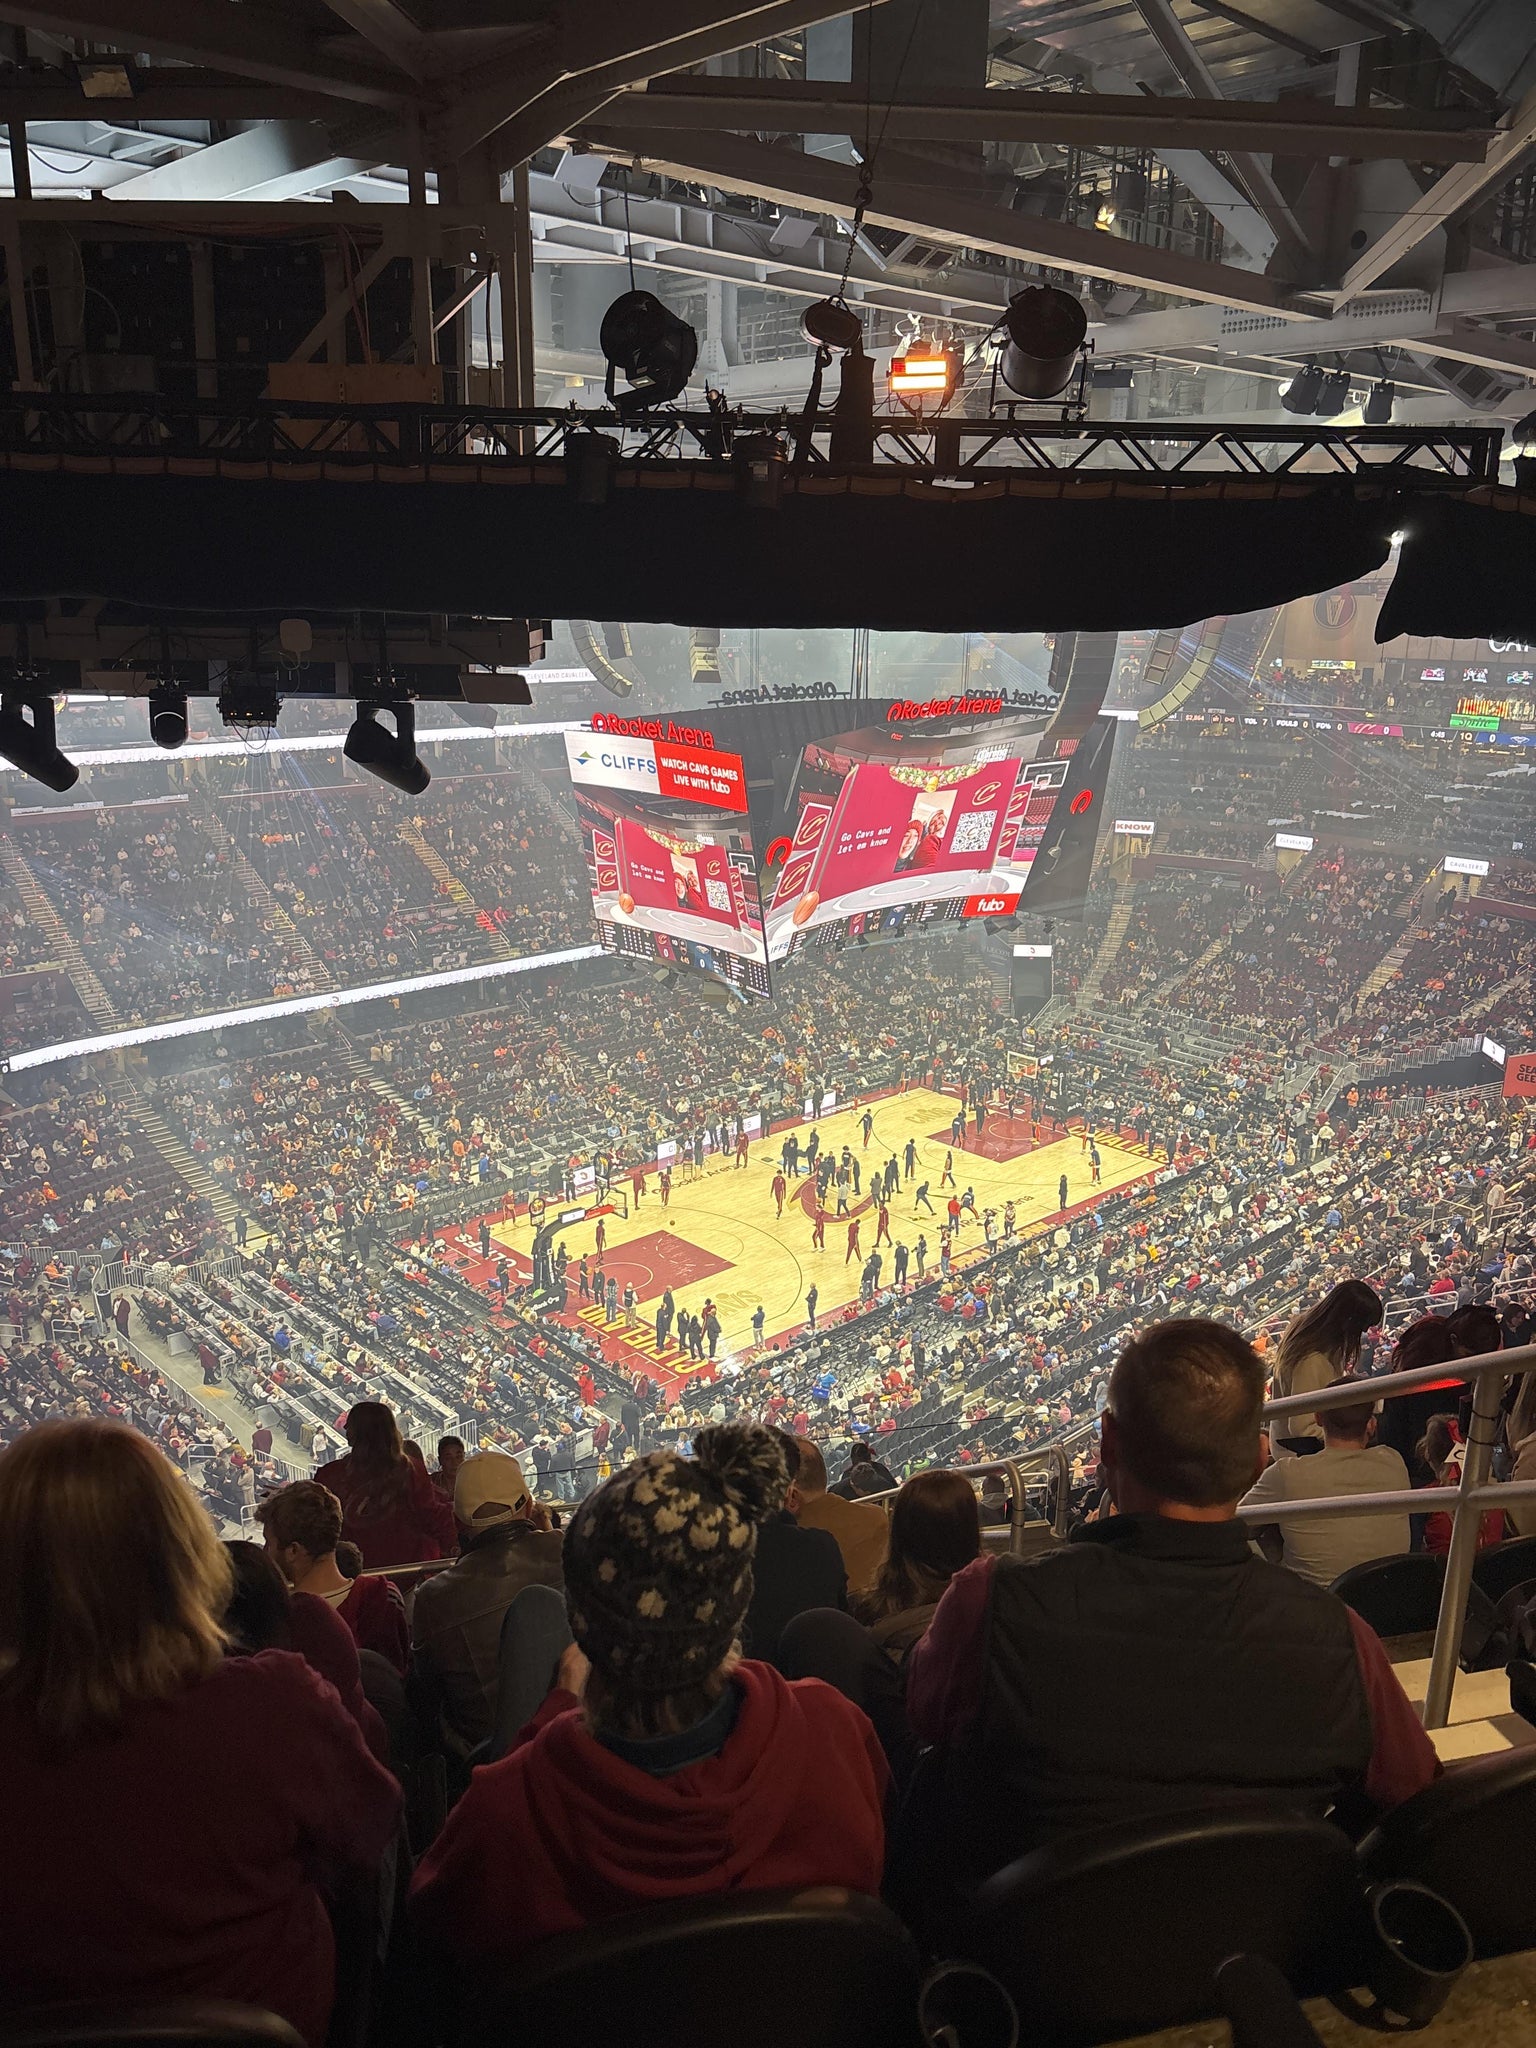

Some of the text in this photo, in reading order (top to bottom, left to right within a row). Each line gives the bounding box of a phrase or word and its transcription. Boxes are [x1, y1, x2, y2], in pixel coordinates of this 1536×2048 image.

[902, 695, 1003, 720] Rocket Arena
[607, 713, 715, 749] Rocket Arena
[1383, 726, 1390, 735] 0
[1458, 717, 1493, 729] Sprite
[1489, 734, 1496, 743] 0
[601, 753, 657, 774] CLIFFS
[660, 757, 739, 781] WATCH CAVS GAMES
[673, 774, 730, 794] LIVE WITH fubo
[841, 825, 892, 842] Go Cavs and
[837, 838, 889, 855] let em know
[976, 897, 1005, 912] fubo
